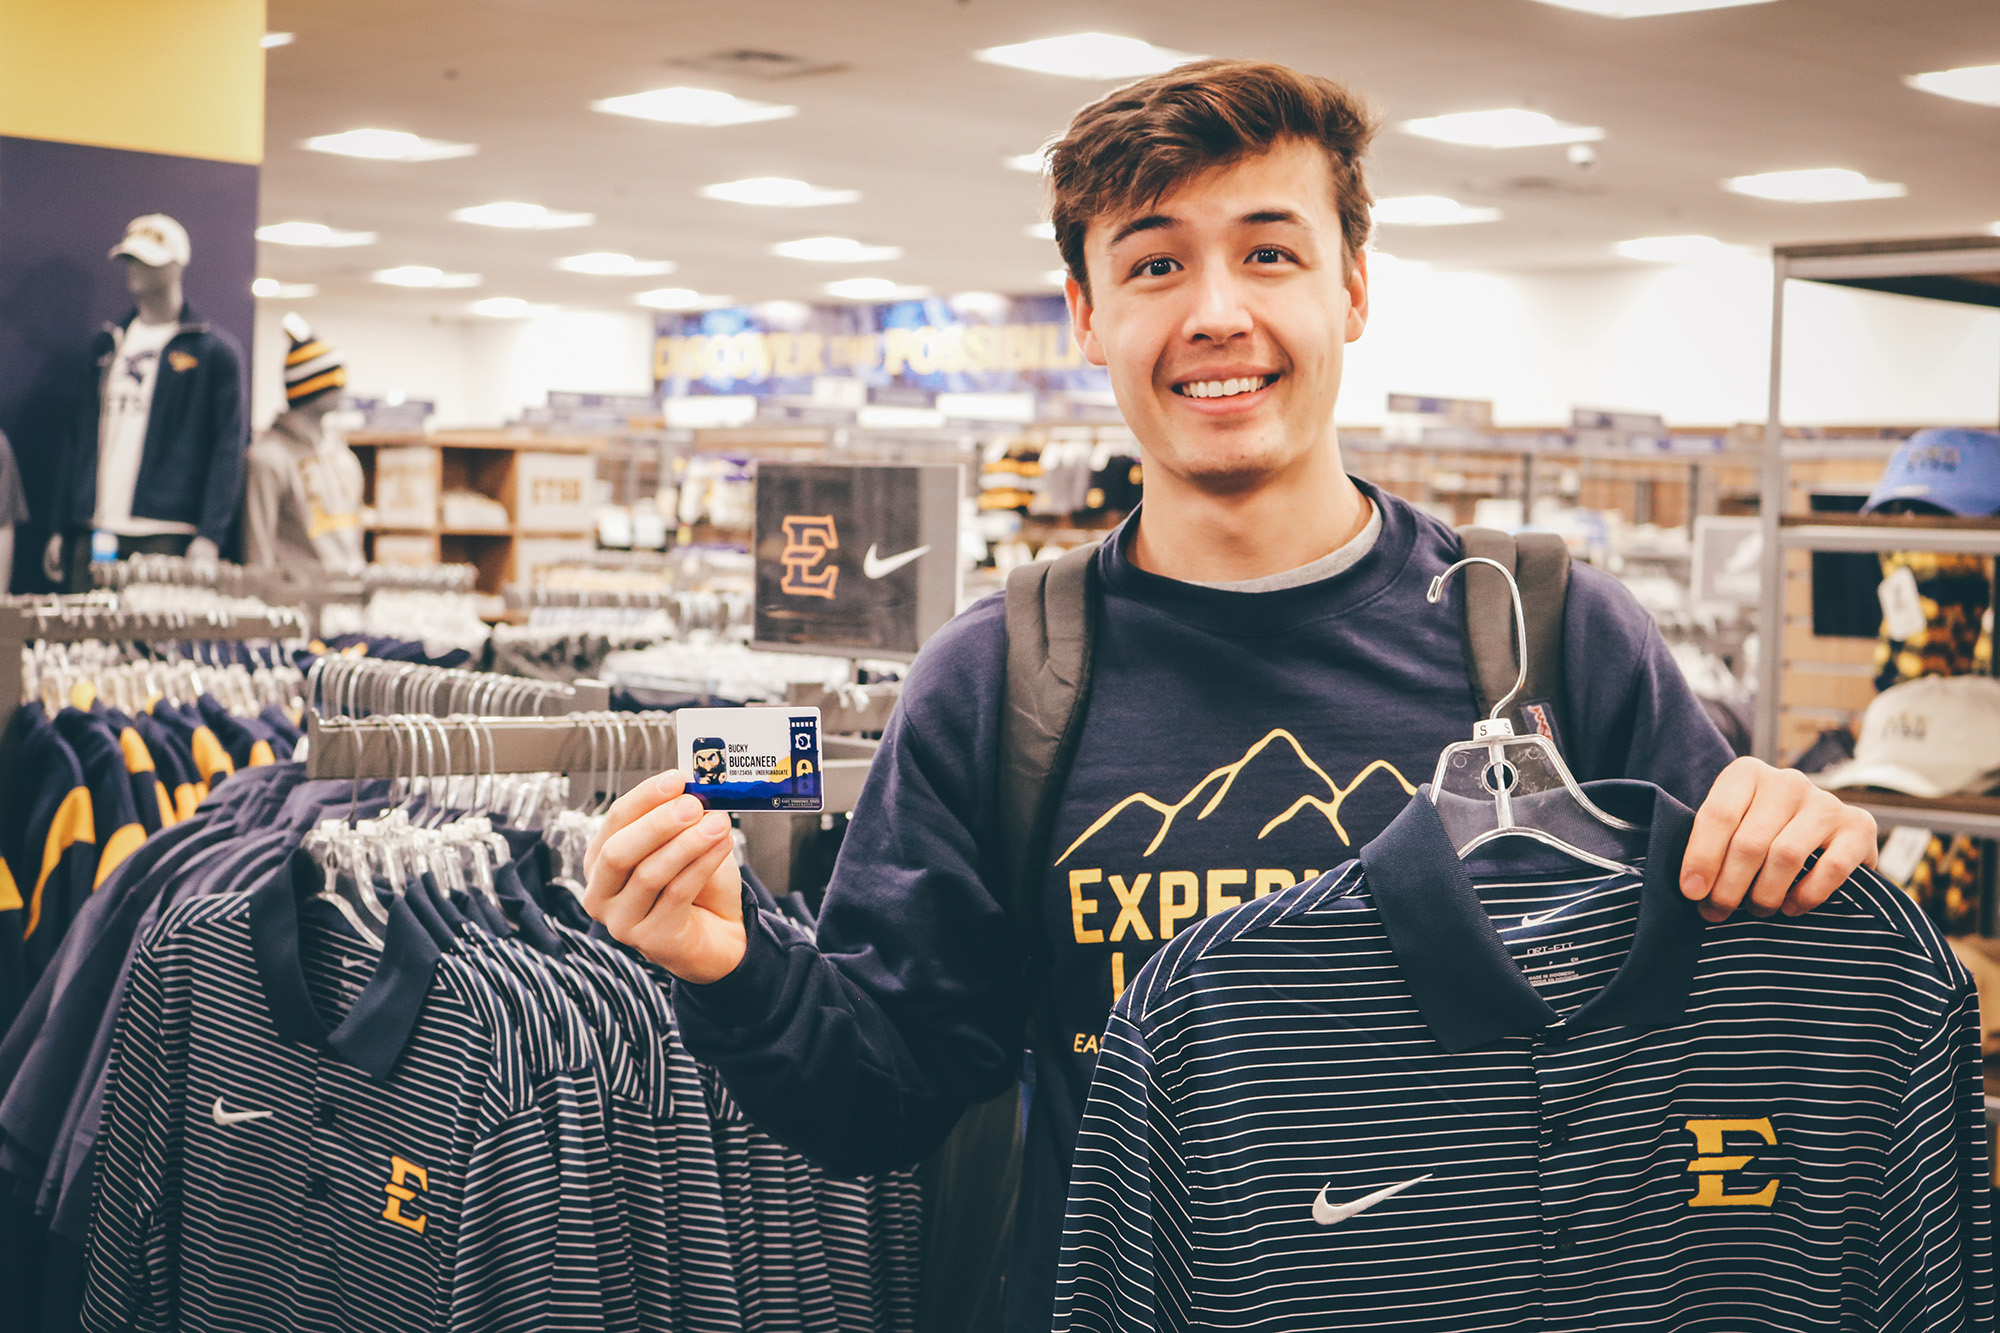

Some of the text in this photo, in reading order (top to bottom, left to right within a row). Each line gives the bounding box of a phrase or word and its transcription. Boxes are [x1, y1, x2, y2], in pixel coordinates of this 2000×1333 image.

[654, 332, 825, 381] DISCOVER
[781, 514, 839, 600] E
[1480, 723, 1511, 736] S S
[728, 744, 749, 753] BUCKY
[729, 756, 777, 767] BUCCANEER
[1073, 1033, 1104, 1054] EA
[1685, 1116, 1781, 1208] E
[382, 1155, 429, 1234] E
